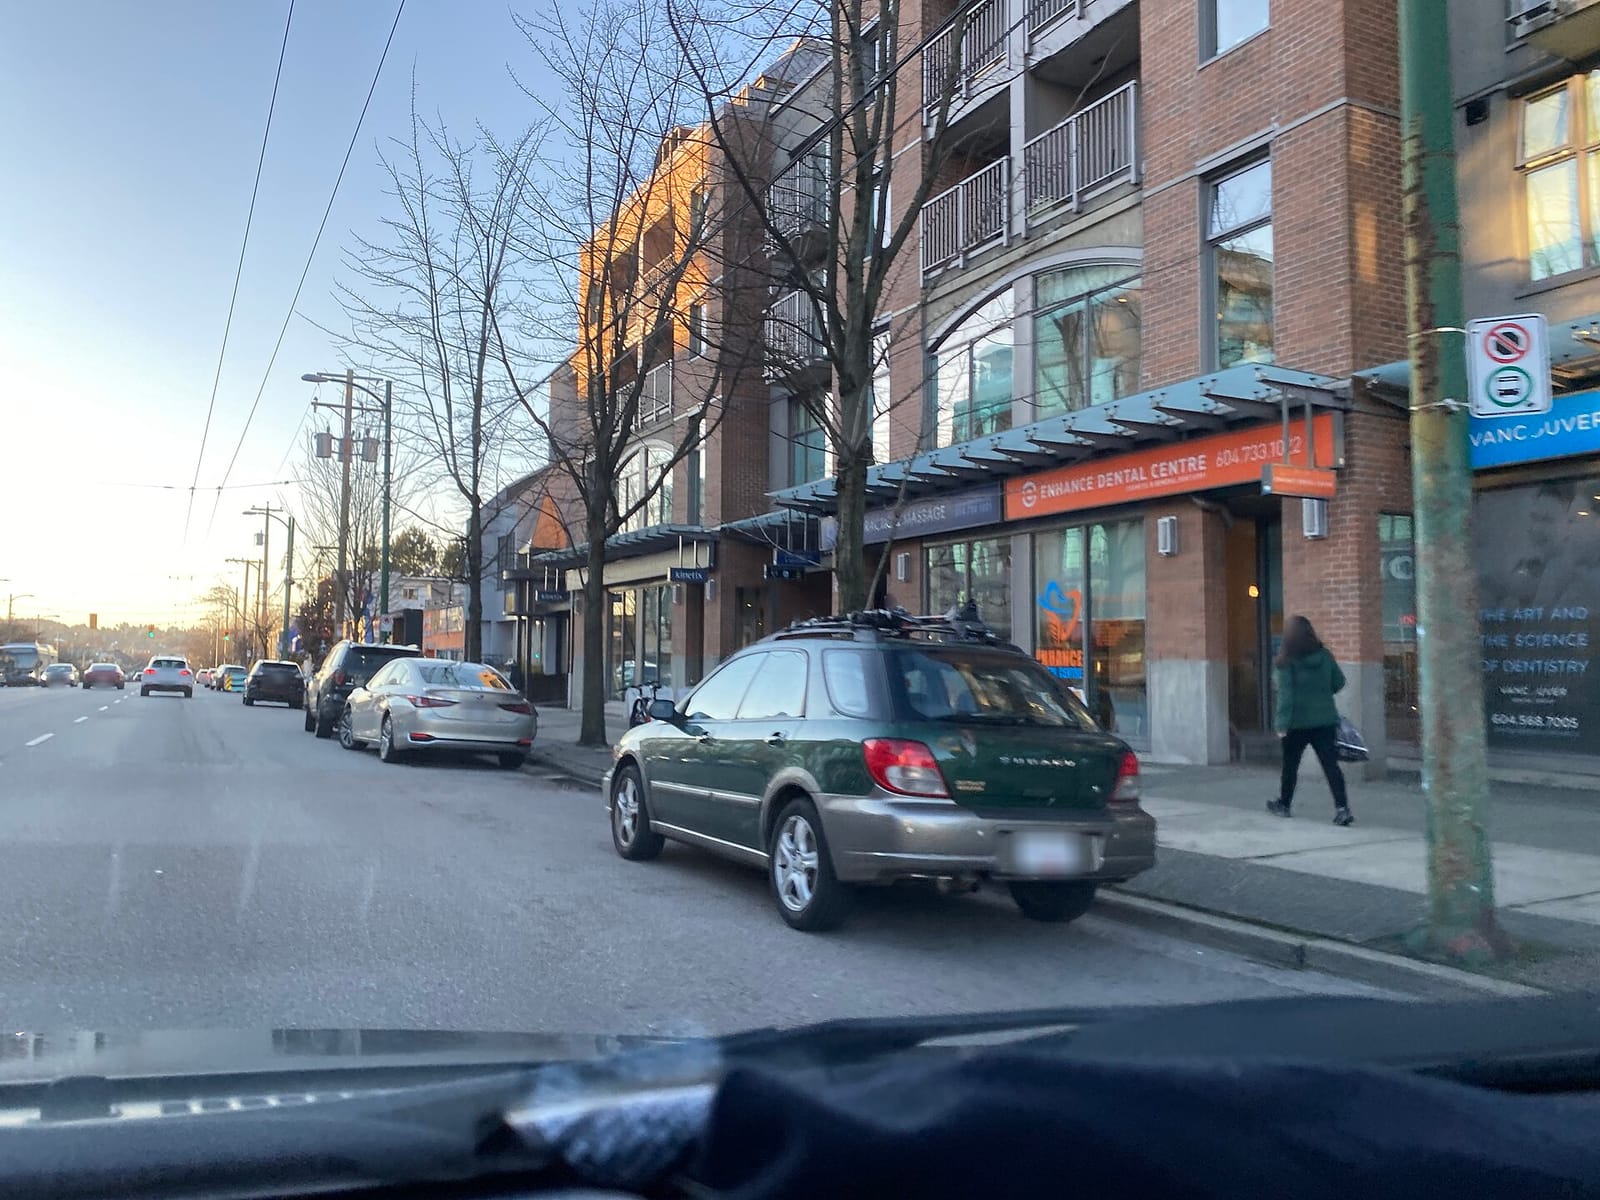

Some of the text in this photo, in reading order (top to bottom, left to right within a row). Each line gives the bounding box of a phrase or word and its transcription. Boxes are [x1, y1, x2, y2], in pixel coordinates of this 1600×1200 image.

[1040, 476, 1094, 499] ENHANCE
[1097, 467, 1147, 489] DENTAL
[1151, 454, 1207, 478] CENTRE
[1513, 607, 1544, 620] ART
[1551, 606, 1588, 620] AND
[1515, 633, 1589, 647] SCIENCE
[1502, 660, 1588, 673] DENTISTRY
